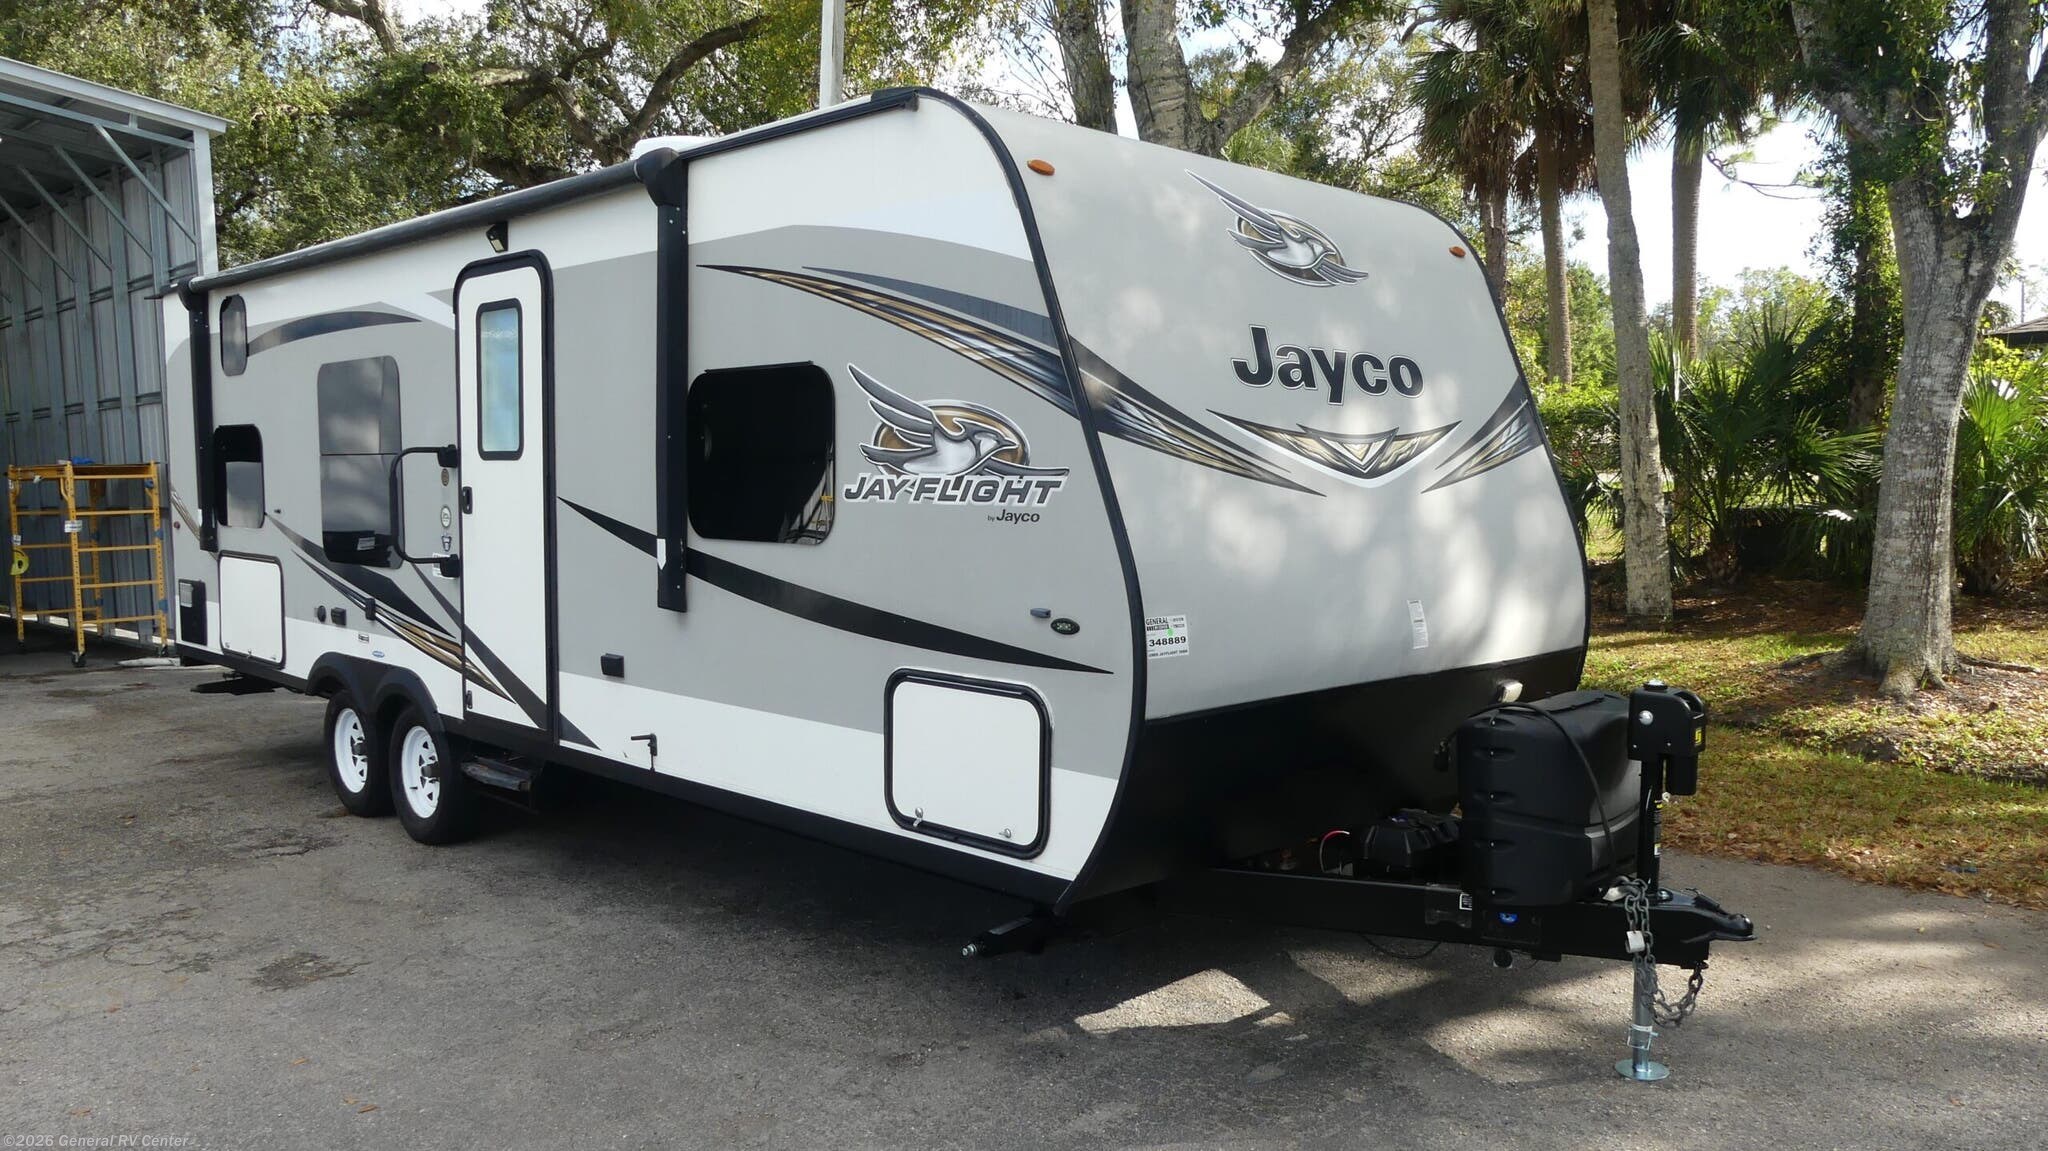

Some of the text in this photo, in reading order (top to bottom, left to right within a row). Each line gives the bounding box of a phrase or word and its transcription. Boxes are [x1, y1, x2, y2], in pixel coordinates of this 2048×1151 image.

[1231, 325, 1424, 405] Jayco
[987, 509, 1040, 524] by Jayco
[1146, 617, 1169, 625] GENERAL
[1148, 636, 1186, 647] 348889
